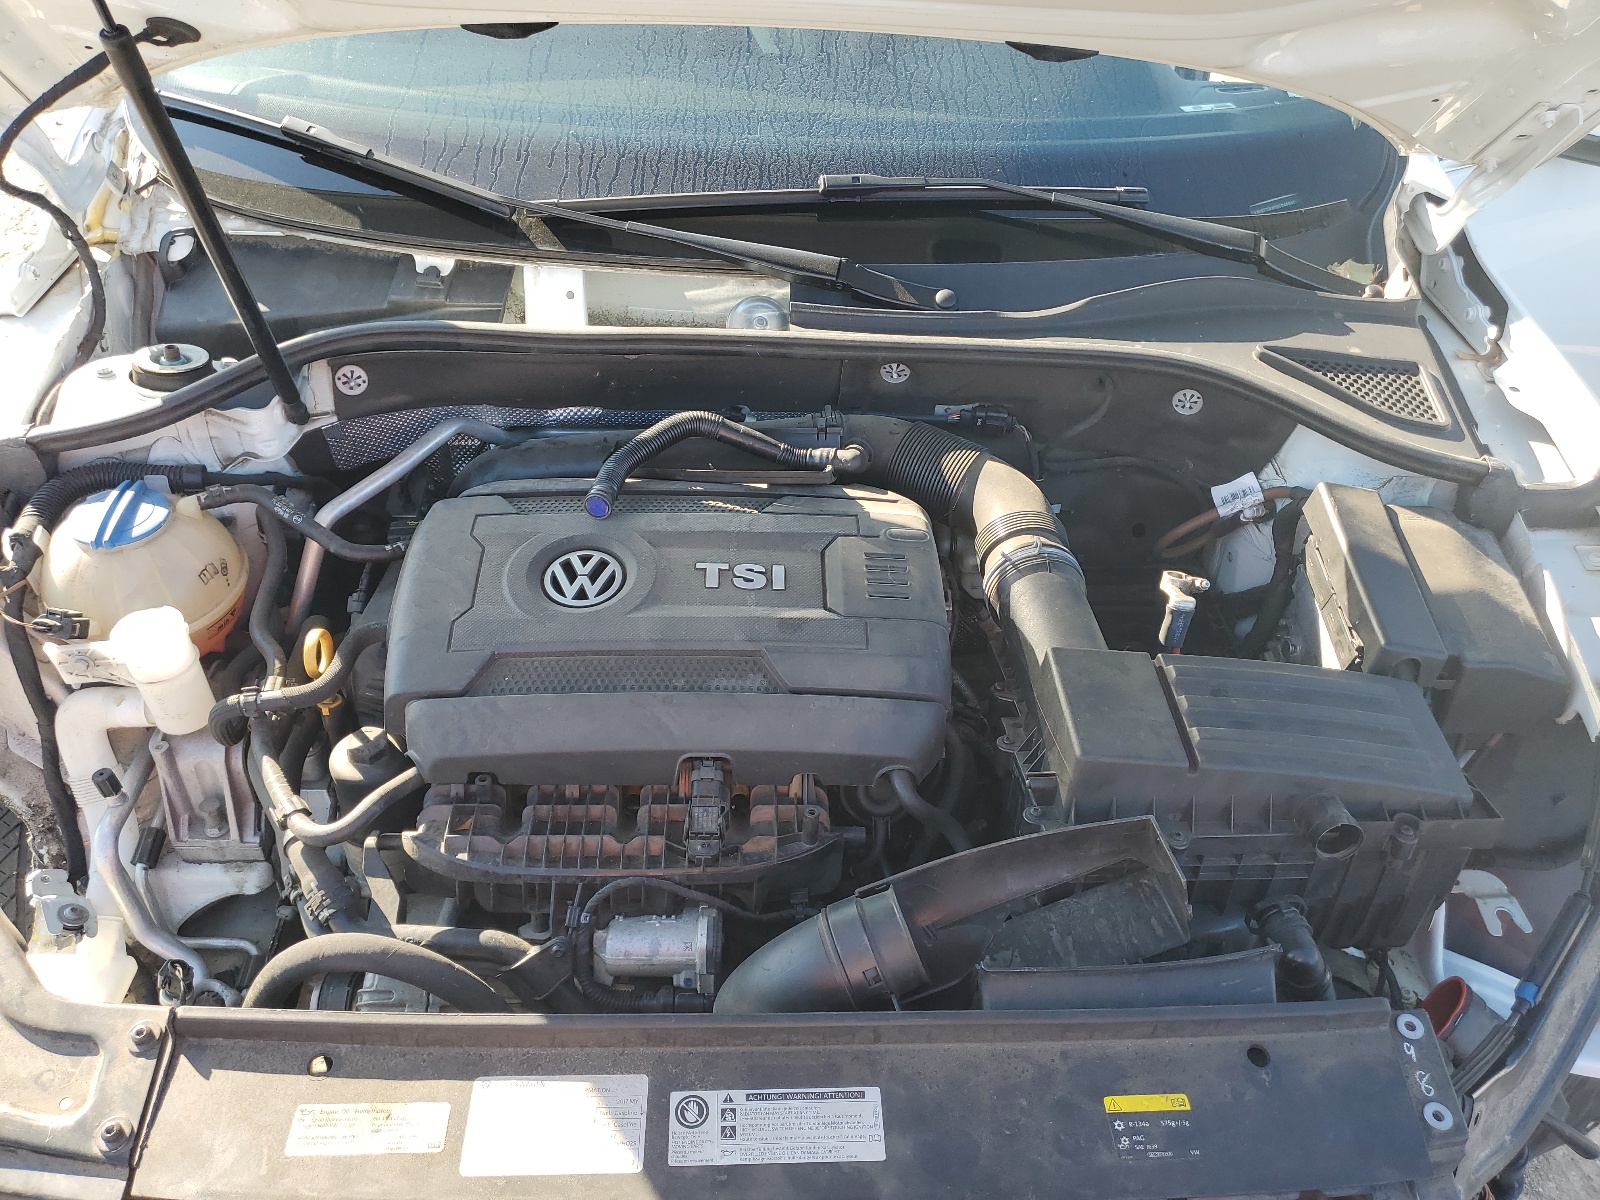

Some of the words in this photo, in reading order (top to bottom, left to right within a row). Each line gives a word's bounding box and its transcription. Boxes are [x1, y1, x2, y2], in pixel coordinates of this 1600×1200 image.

[695, 562, 786, 590] TSI
[748, 1093, 785, 1101] ACHTUNG!
[786, 1092, 822, 1100] WARNING!
[823, 1091, 864, 1100] ATTENTION!
